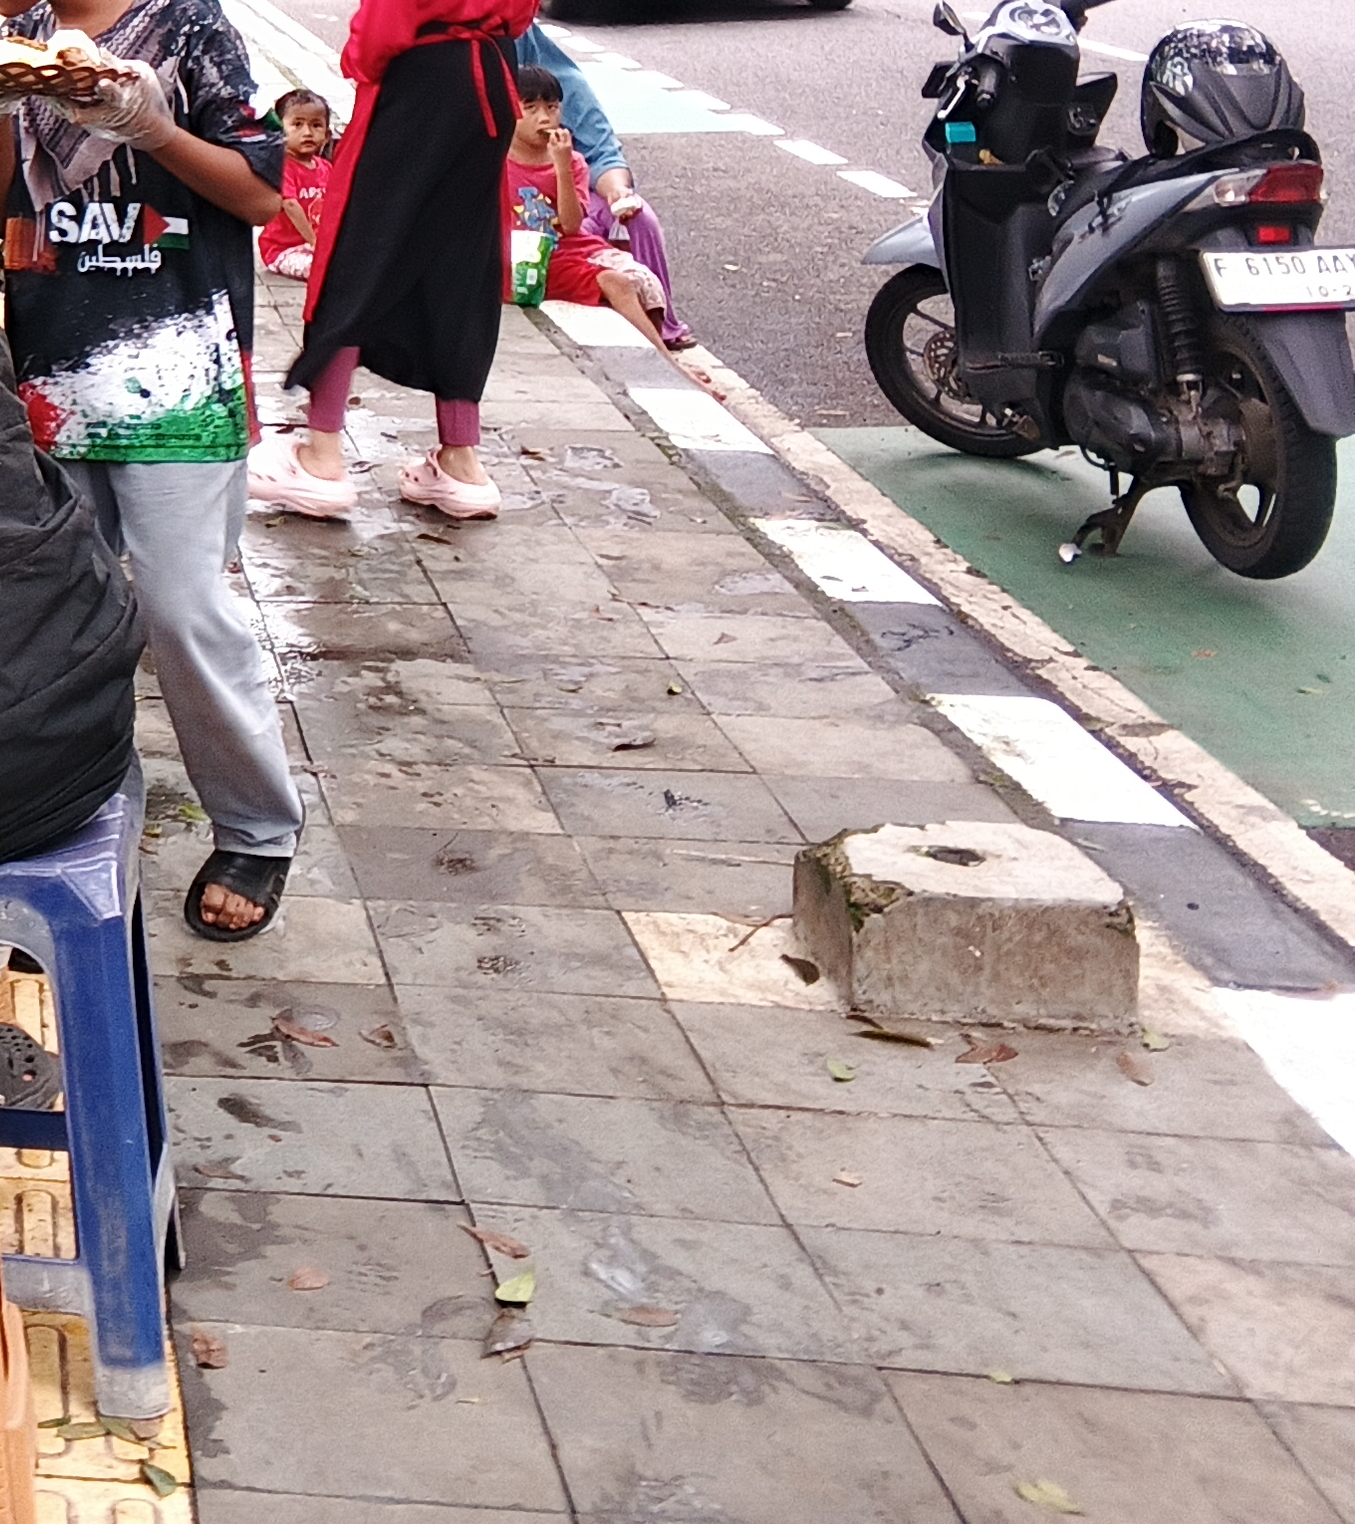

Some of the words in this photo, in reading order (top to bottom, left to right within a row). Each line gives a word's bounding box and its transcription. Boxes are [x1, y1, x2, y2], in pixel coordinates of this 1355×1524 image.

[77, 242, 162, 277] فلسطين
[1213, 258, 1228, 278] F
[1245, 255, 1307, 276] 6150
